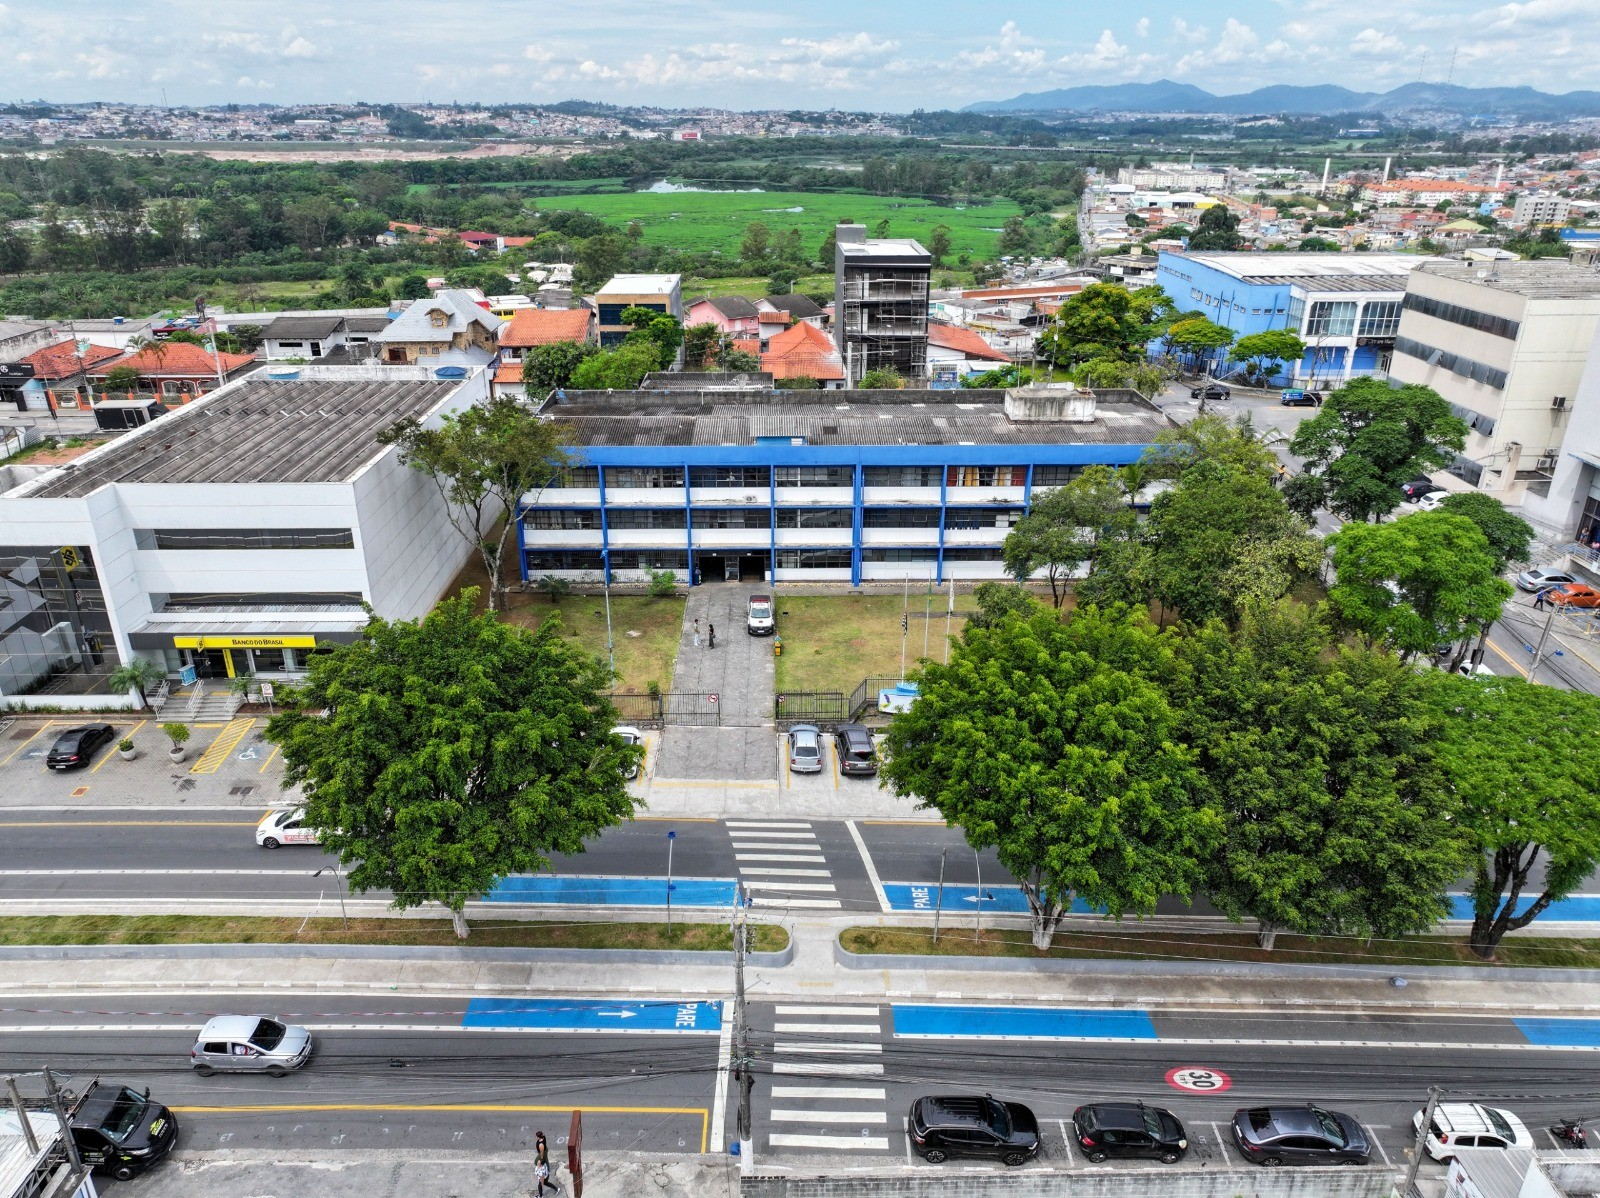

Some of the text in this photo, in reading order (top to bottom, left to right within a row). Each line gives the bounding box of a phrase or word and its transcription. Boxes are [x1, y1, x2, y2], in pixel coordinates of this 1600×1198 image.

[911, 887, 931, 909] PARE
[675, 1003, 698, 1028] PARE
[1188, 1072, 1215, 1088] 30
